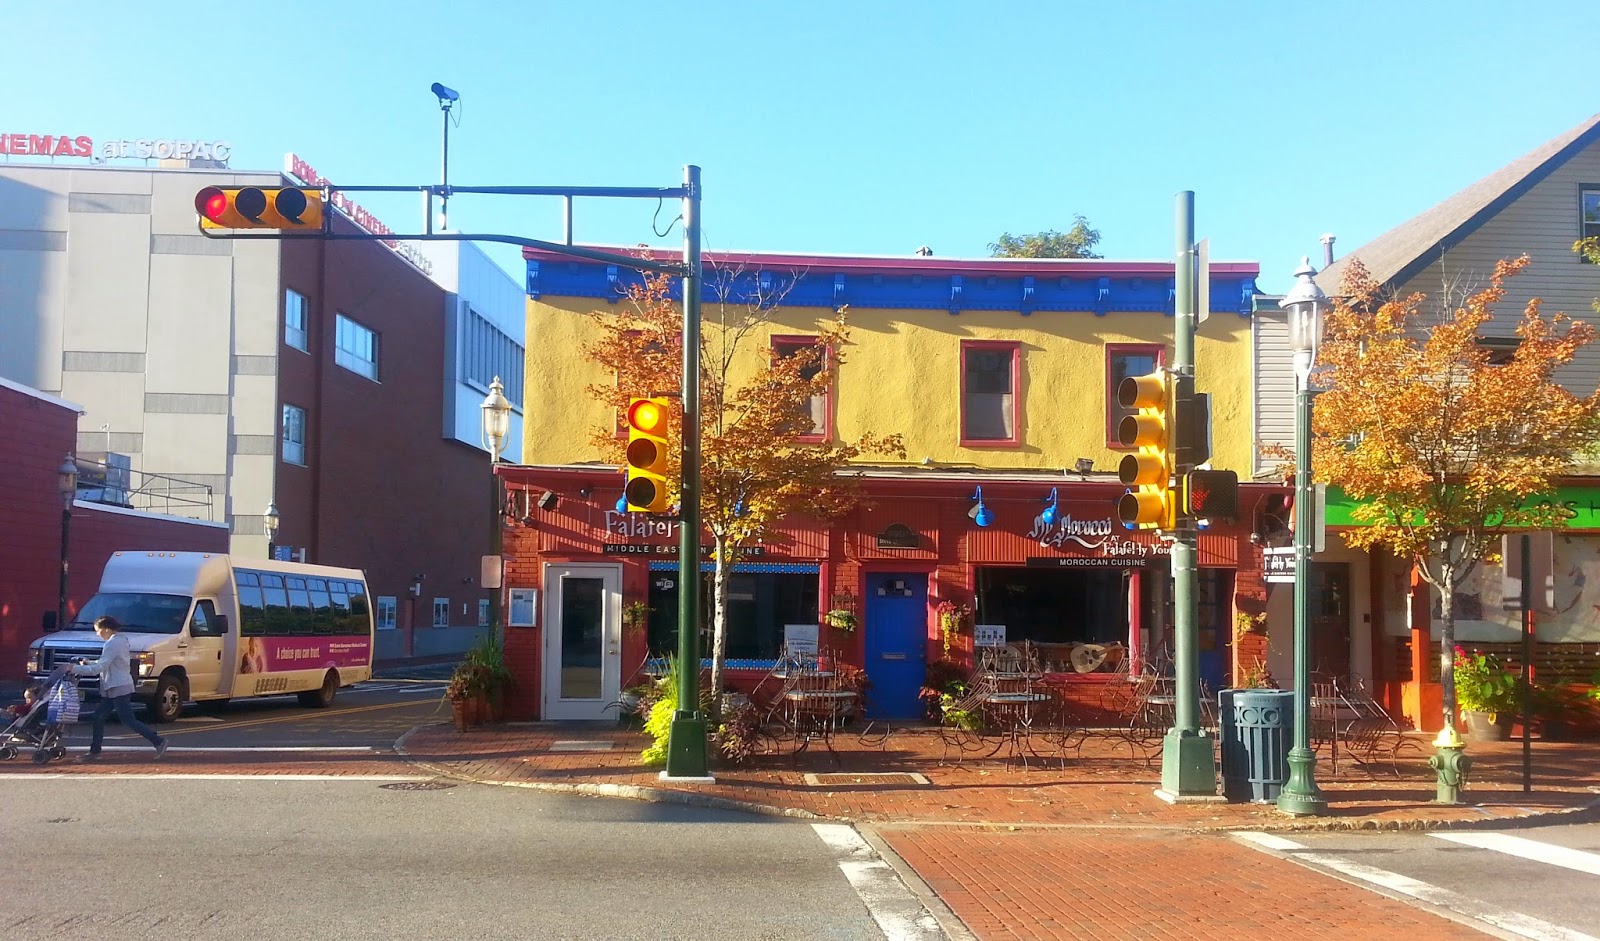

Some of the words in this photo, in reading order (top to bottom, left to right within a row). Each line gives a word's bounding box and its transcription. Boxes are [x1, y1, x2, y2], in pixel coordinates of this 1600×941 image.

[103, 139, 125, 158] at
[135, 138, 230, 161] SOPAC
[1054, 513, 1112, 548] Morocco
[606, 545, 650, 553] MIDDLE
[1151, 543, 1171, 555] You
[276, 647, 280, 659] A
[281, 647, 294, 660] choice
[294, 649, 302, 661] you
[302, 648, 310, 659] can
